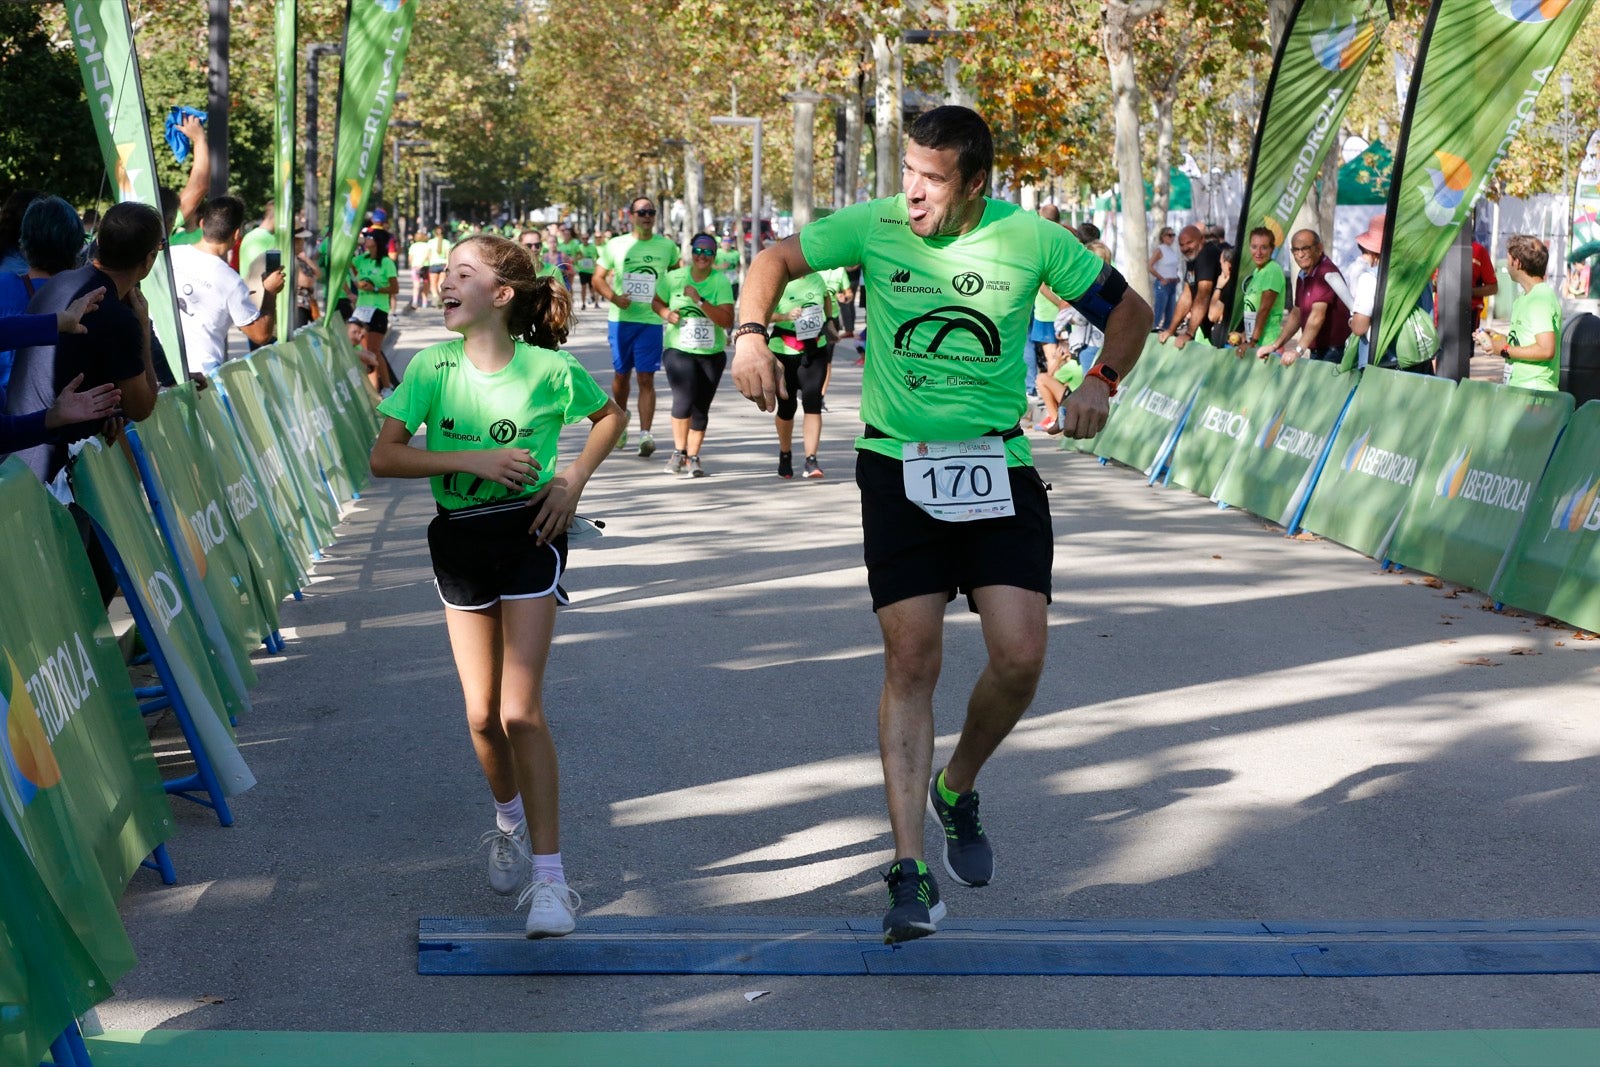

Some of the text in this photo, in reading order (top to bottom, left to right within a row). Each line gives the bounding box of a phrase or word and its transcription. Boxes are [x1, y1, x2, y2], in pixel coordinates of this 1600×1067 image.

[1275, 87, 1344, 222] IBERDROLA
[626, 281, 650, 295] 283
[893, 285, 942, 294] IBERDROLA
[800, 315, 821, 331] 383
[922, 464, 992, 499] 170
[1357, 446, 1417, 487] IBERDROLA
[1460, 468, 1532, 512] IBERDROLA
